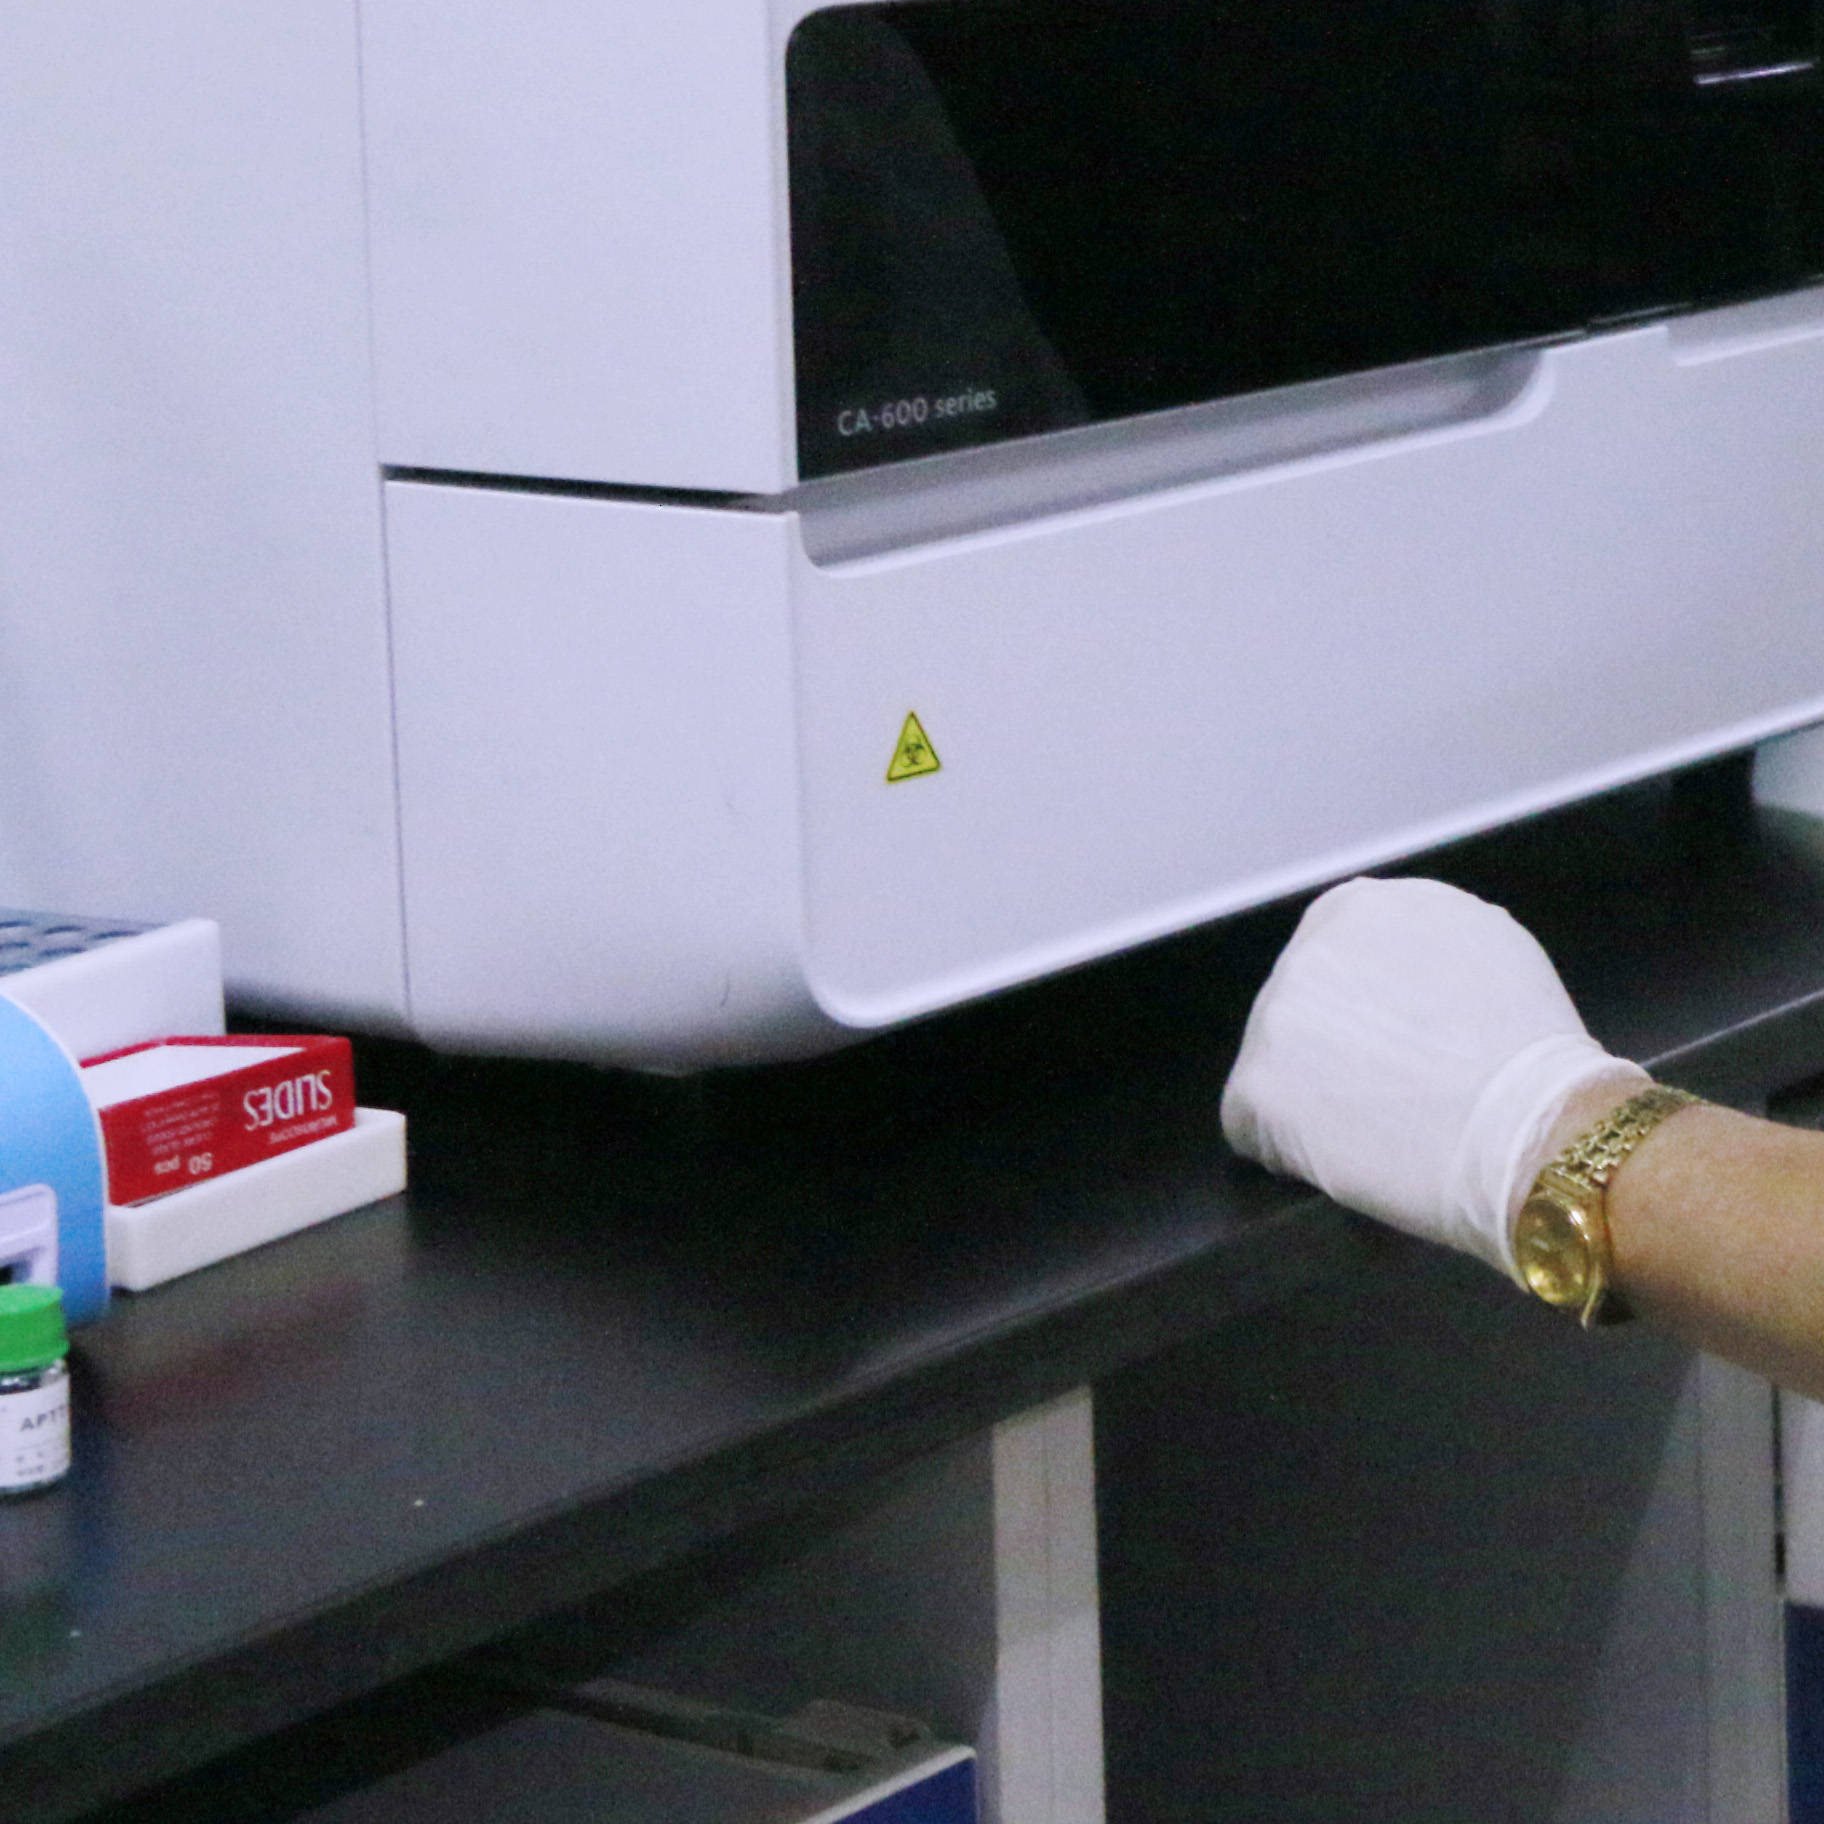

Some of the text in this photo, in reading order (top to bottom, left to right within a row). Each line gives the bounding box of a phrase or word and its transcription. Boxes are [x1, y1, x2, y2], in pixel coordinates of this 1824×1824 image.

[837, 388, 997, 436] CA-600 series
[242, 1069, 333, 1132] SLIDES
